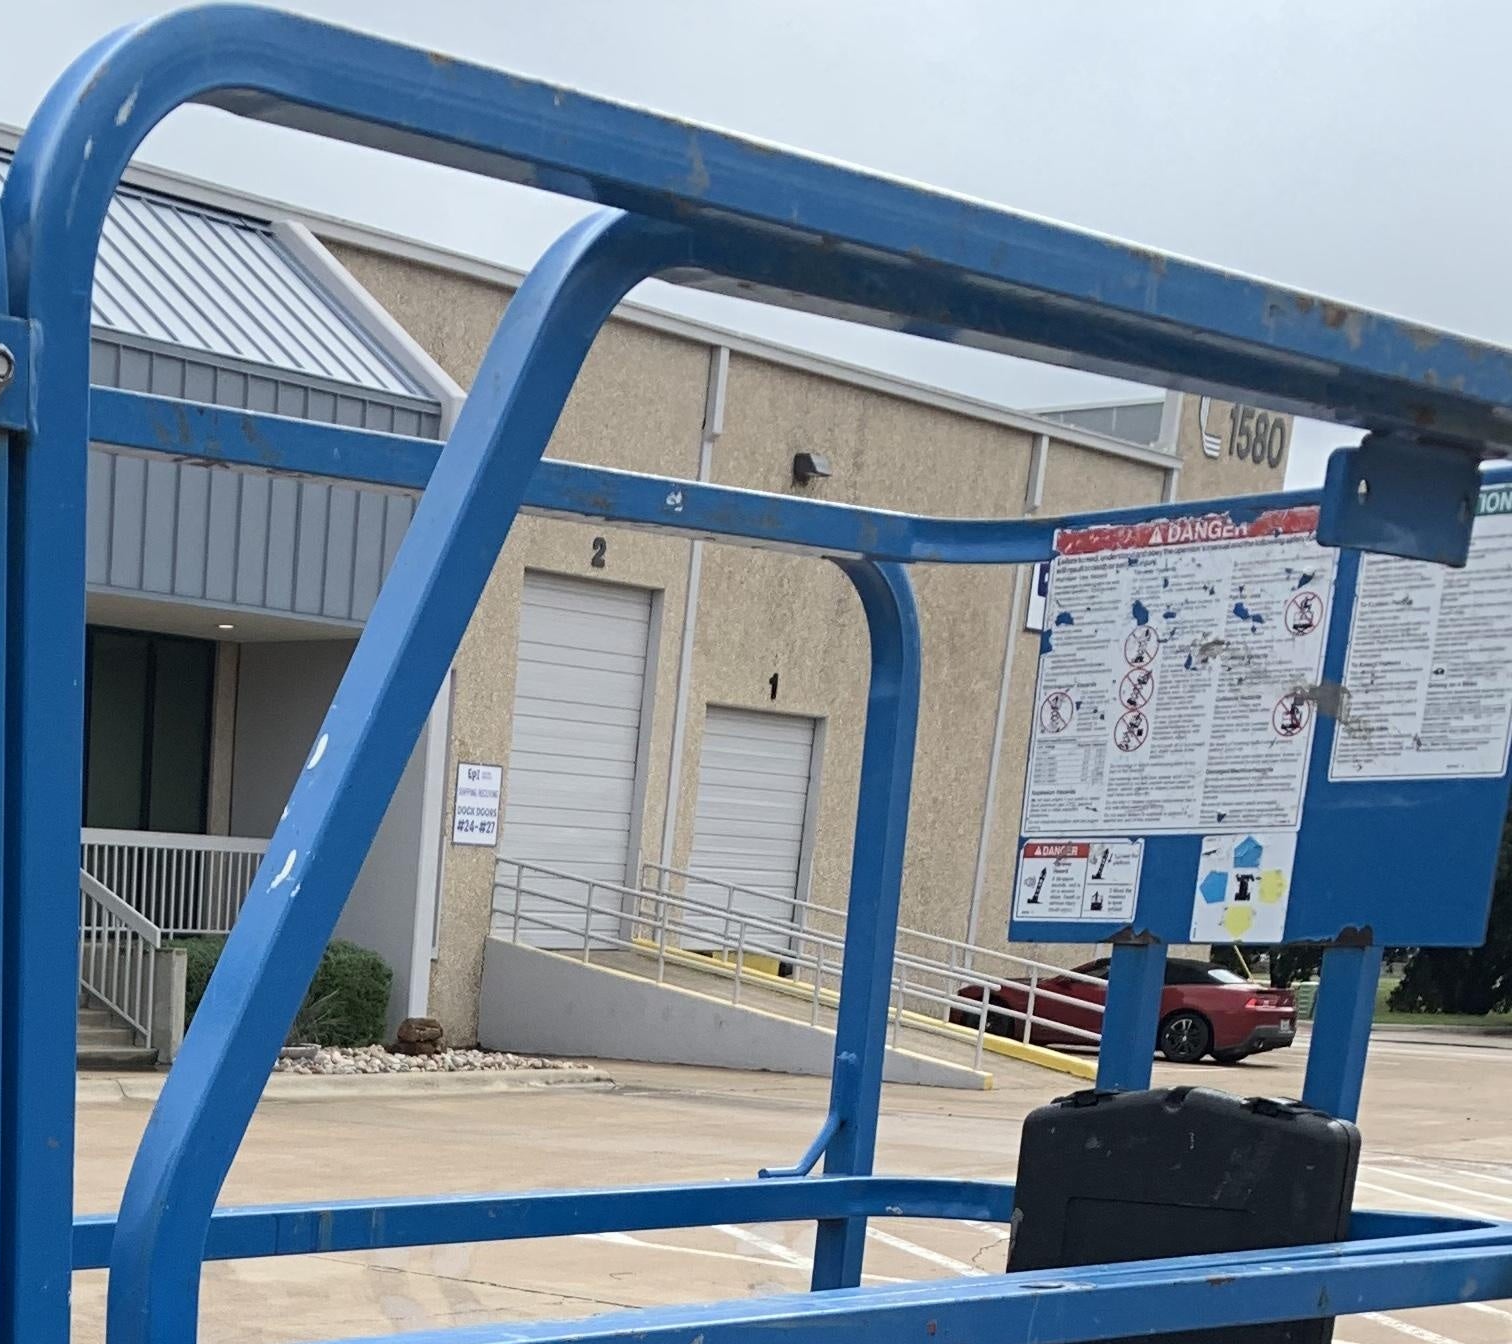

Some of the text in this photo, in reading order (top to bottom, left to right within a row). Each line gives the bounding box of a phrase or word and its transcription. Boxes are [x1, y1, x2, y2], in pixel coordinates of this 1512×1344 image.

[1229, 403, 1285, 468] 1580
[592, 537, 606, 568] 2
[769, 673, 778, 699] 1
